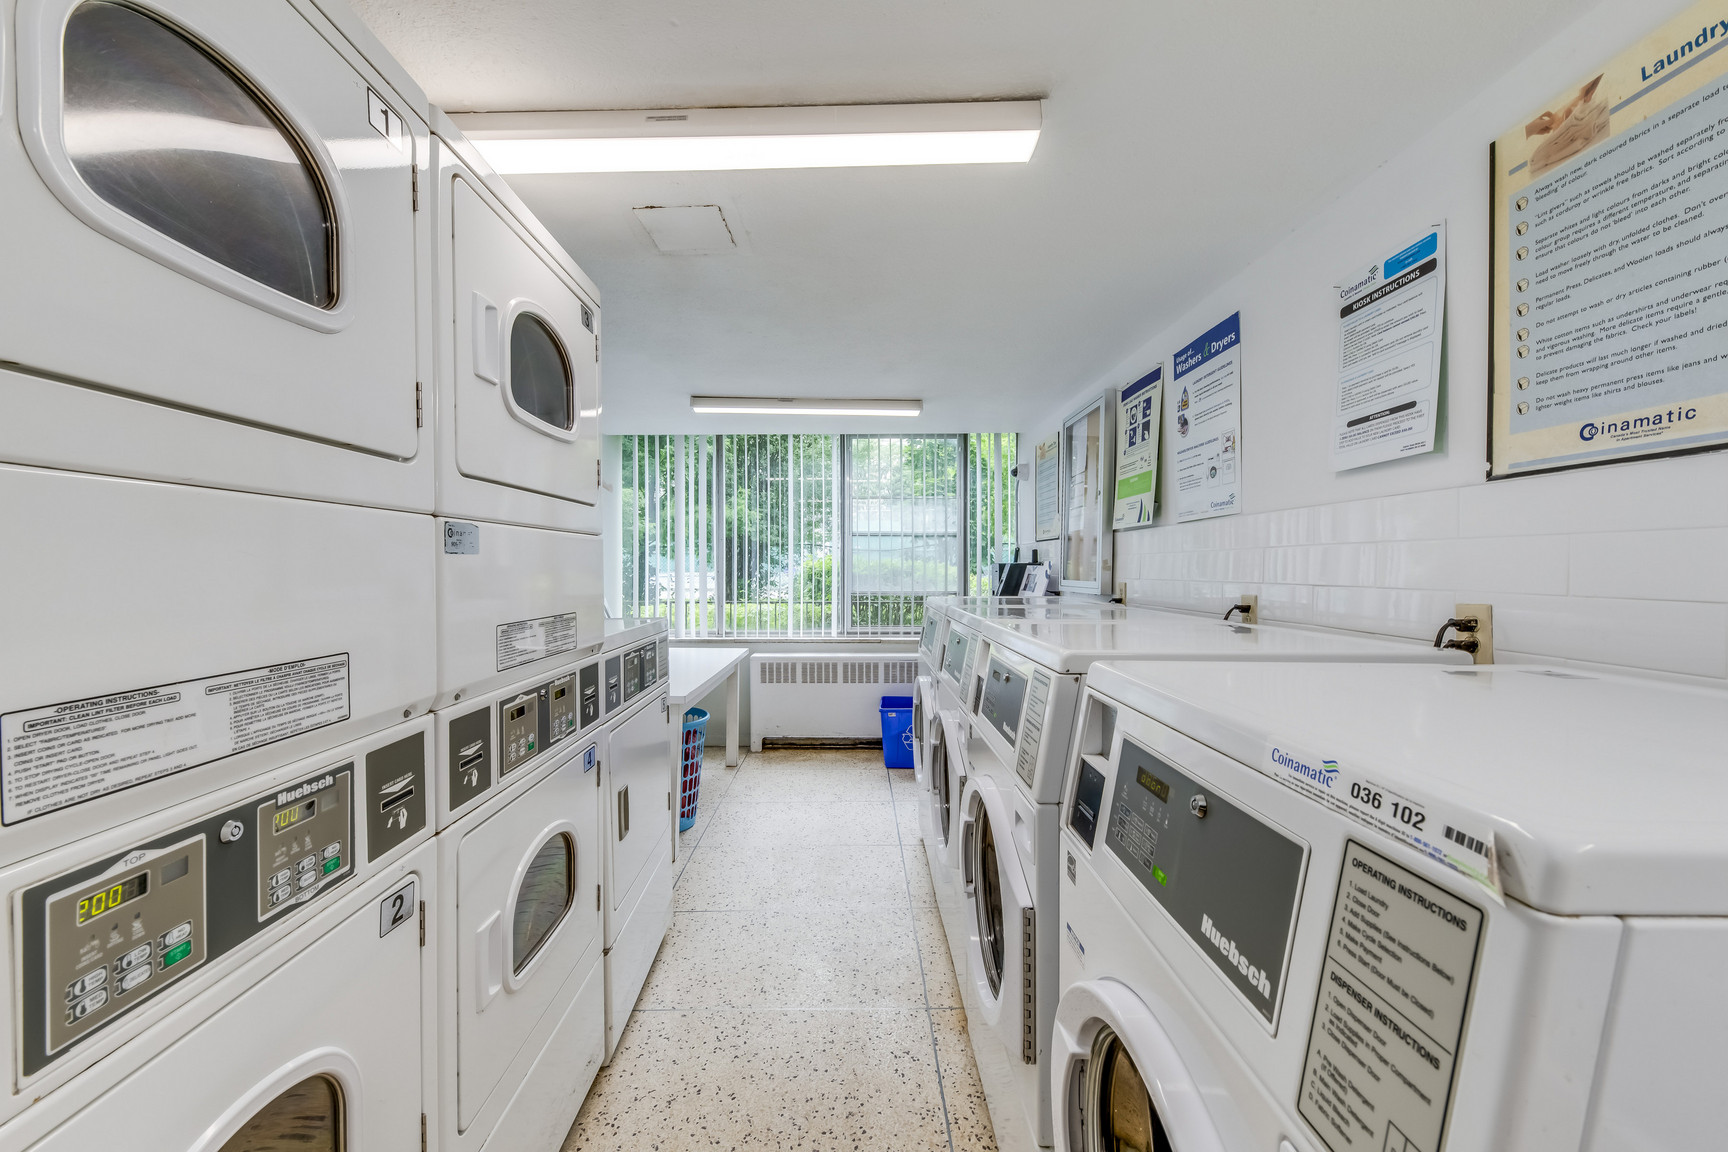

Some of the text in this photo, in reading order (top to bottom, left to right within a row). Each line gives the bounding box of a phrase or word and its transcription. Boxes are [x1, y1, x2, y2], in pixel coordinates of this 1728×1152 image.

[1641, 19, 1728, 82] Laundry
[381, 109, 389, 137] 1
[1534, 182, 1553, 195] Always
[1554, 173, 1568, 184] wash
[1570, 166, 1582, 175] new,
[1583, 157, 1597, 168] dark
[1599, 139, 1627, 159] coloured
[1628, 127, 1650, 143] fabrics
[1652, 122, 1659, 130] in
[1667, 100, 1700, 121] separate
[1702, 87, 1719, 102] load
[1534, 218, 1547, 228] such
[1555, 201, 1581, 217] corduroy
[1591, 184, 1614, 199] wrinkle
[1615, 177, 1629, 186] free
[1630, 165, 1654, 179] fabrics.
[1658, 154, 1674, 166] Sort
[1676, 134, 1714, 156] according
[1716, 128, 1725, 136] to
[1535, 249, 1553, 260] ensure
[1554, 243, 1566, 252] that
[1566, 233, 1588, 246] colours
[1600, 222, 1611, 231] not
[1634, 206, 1648, 215] into
[1650, 197, 1666, 208] each
[1668, 186, 1690, 200] other.
[1535, 275, 1548, 285] need
[1557, 266, 1573, 276] move
[1574, 259, 1590, 269] freely
[1592, 248, 1616, 262] through
[1618, 243, 1629, 251] the
[1630, 234, 1650, 245] water
[1673, 210, 1704, 228] cleaned.
[1340, 272, 1377, 299] Coinamatic
[1352, 295, 1371, 311] KIOSK
[1371, 269, 1420, 300] INSTRUCTIONS
[1556, 309, 1579, 321] attempt
[1588, 300, 1604, 309] wash
[1628, 284, 1652, 296] articles
[1654, 269, 1691, 286] containing
[1694, 259, 1721, 272] rubber
[585, 311, 589, 327] 3
[1175, 332, 1236, 375] Washers & Dryers
[1175, 350, 1188, 364] Usage
[1535, 368, 1558, 378] Delicate
[1559, 361, 1584, 373] products
[1585, 356, 1596, 364] will
[1610, 348, 1628, 358] much
[1630, 342, 1651, 352] longer
[1660, 331, 1687, 344] washed
[1690, 326, 1704, 336] and
[1706, 320, 1727, 331] dried
[1210, 499, 1234, 509] Coinamatic
[27, 716, 66, 729] IMPORTANT:
[68, 712, 90, 720] CLEAN
[105, 705, 124, 713] FILTER
[125, 700, 147, 709] BEFORE
[33, 760, 55, 769] "START"
[78, 750, 99, 758] BUTTON
[587, 752, 592, 767] 4
[1271, 747, 1334, 788] Coinamatic
[277, 775, 334, 806] Huebsch
[382, 772, 412, 790] INSERT CARD HERE
[1351, 782, 1382, 810] 036
[1391, 801, 1426, 831] 102
[123, 852, 147, 867] TOP
[295, 884, 320, 903] BOTTOM
[1352, 857, 1396, 890] OPERATING
[1397, 883, 1467, 931] INSTRUCTIONS
[1352, 895, 1380, 918] Close Door
[1354, 883, 1389, 911] Load Laundry
[391, 894, 404, 926] 2
[135, 947, 147, 956] LOW
[170, 944, 186, 956] START
[1344, 931, 1382, 963] Make Payment
[1347, 919, 1402, 963] Make Cycle Selection
[1349, 907, 1454, 985] Add Supplies (See Instructions Below)
[134, 953, 148, 962] TEMP
[1200, 913, 1272, 1000] Huebsch
[88, 976, 103, 986] TEMP
[89, 991, 103, 1001] MED
[89, 999, 104, 1008] TEMP
[1330, 971, 1440, 1070] DISPENSER INSTRUCTIONS
